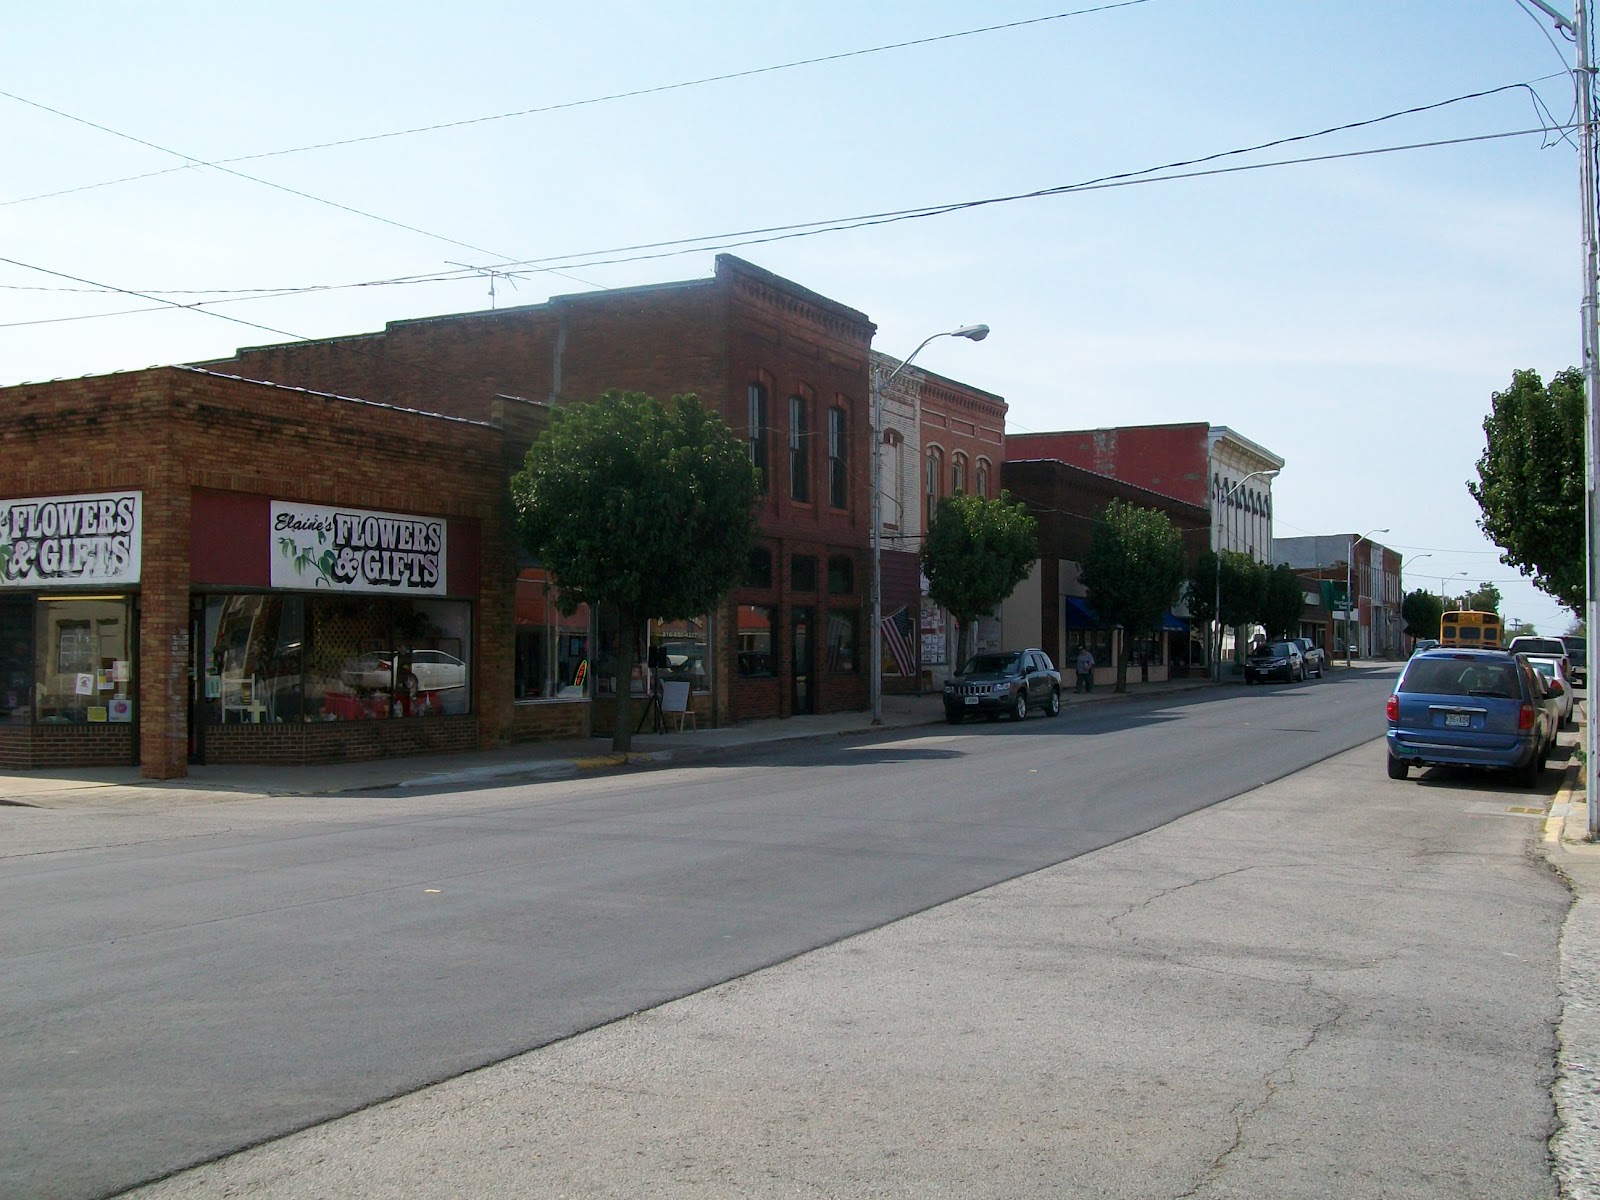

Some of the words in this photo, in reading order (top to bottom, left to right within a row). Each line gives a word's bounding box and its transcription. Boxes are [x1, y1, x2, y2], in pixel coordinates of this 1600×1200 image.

[10, 497, 135, 539] FLOWERS
[274, 512, 334, 532] Elaine's
[334, 512, 442, 553] FLOWERS
[8, 540, 37, 579] &
[39, 534, 131, 578] GIFTS
[331, 547, 359, 584] &
[363, 549, 439, 587] GIFTS
